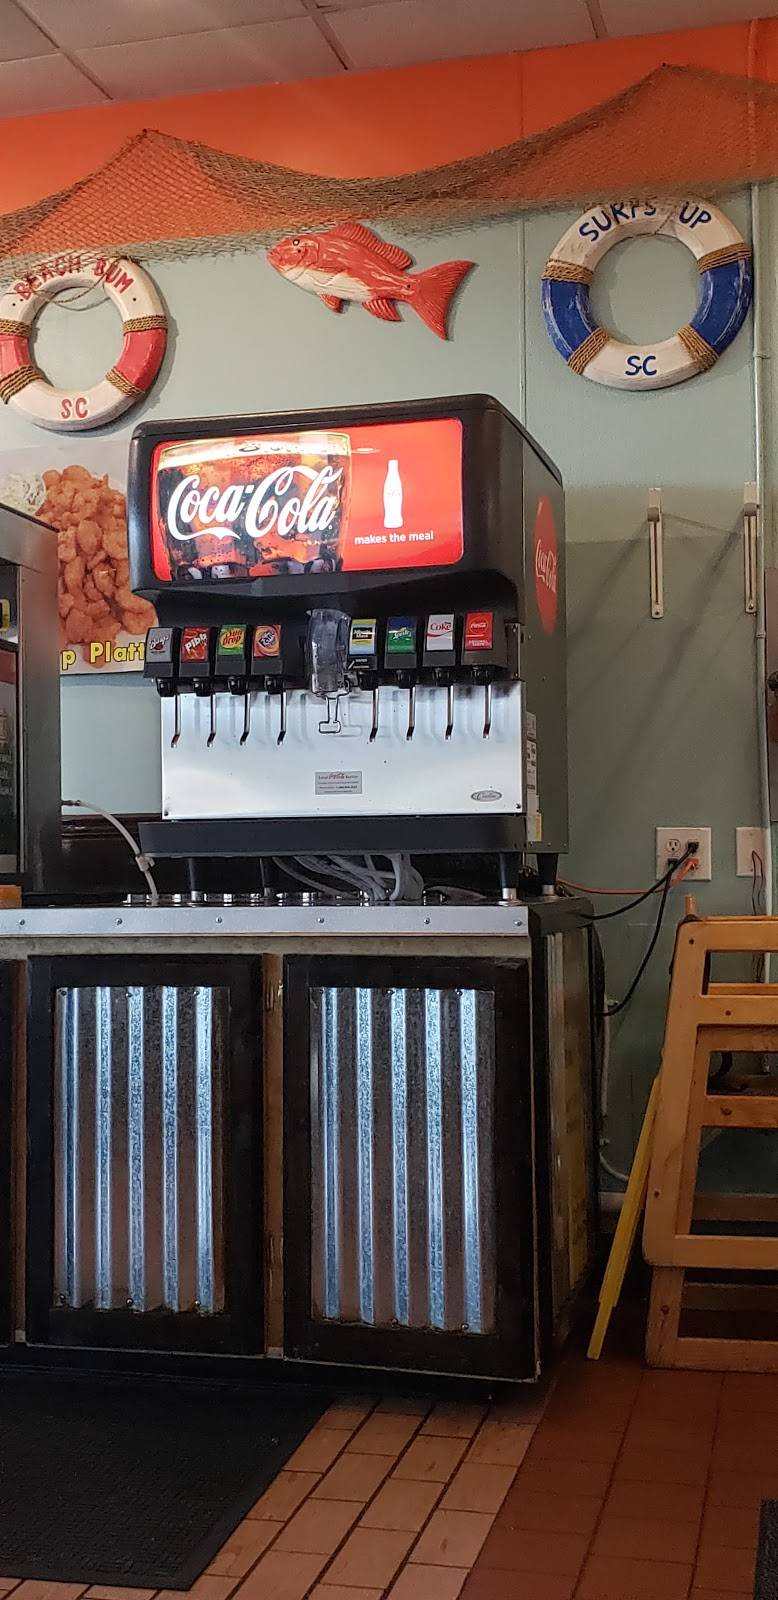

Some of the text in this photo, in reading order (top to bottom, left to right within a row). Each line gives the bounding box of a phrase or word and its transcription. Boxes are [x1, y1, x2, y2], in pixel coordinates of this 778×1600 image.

[679, 201, 712, 229] UP
[94, 257, 135, 295] BUM
[60, 397, 89, 419] SC
[167, 465, 344, 541] Coca-Cola
[354, 530, 434, 545] makes the meal
[430, 622, 451, 631] Coke
